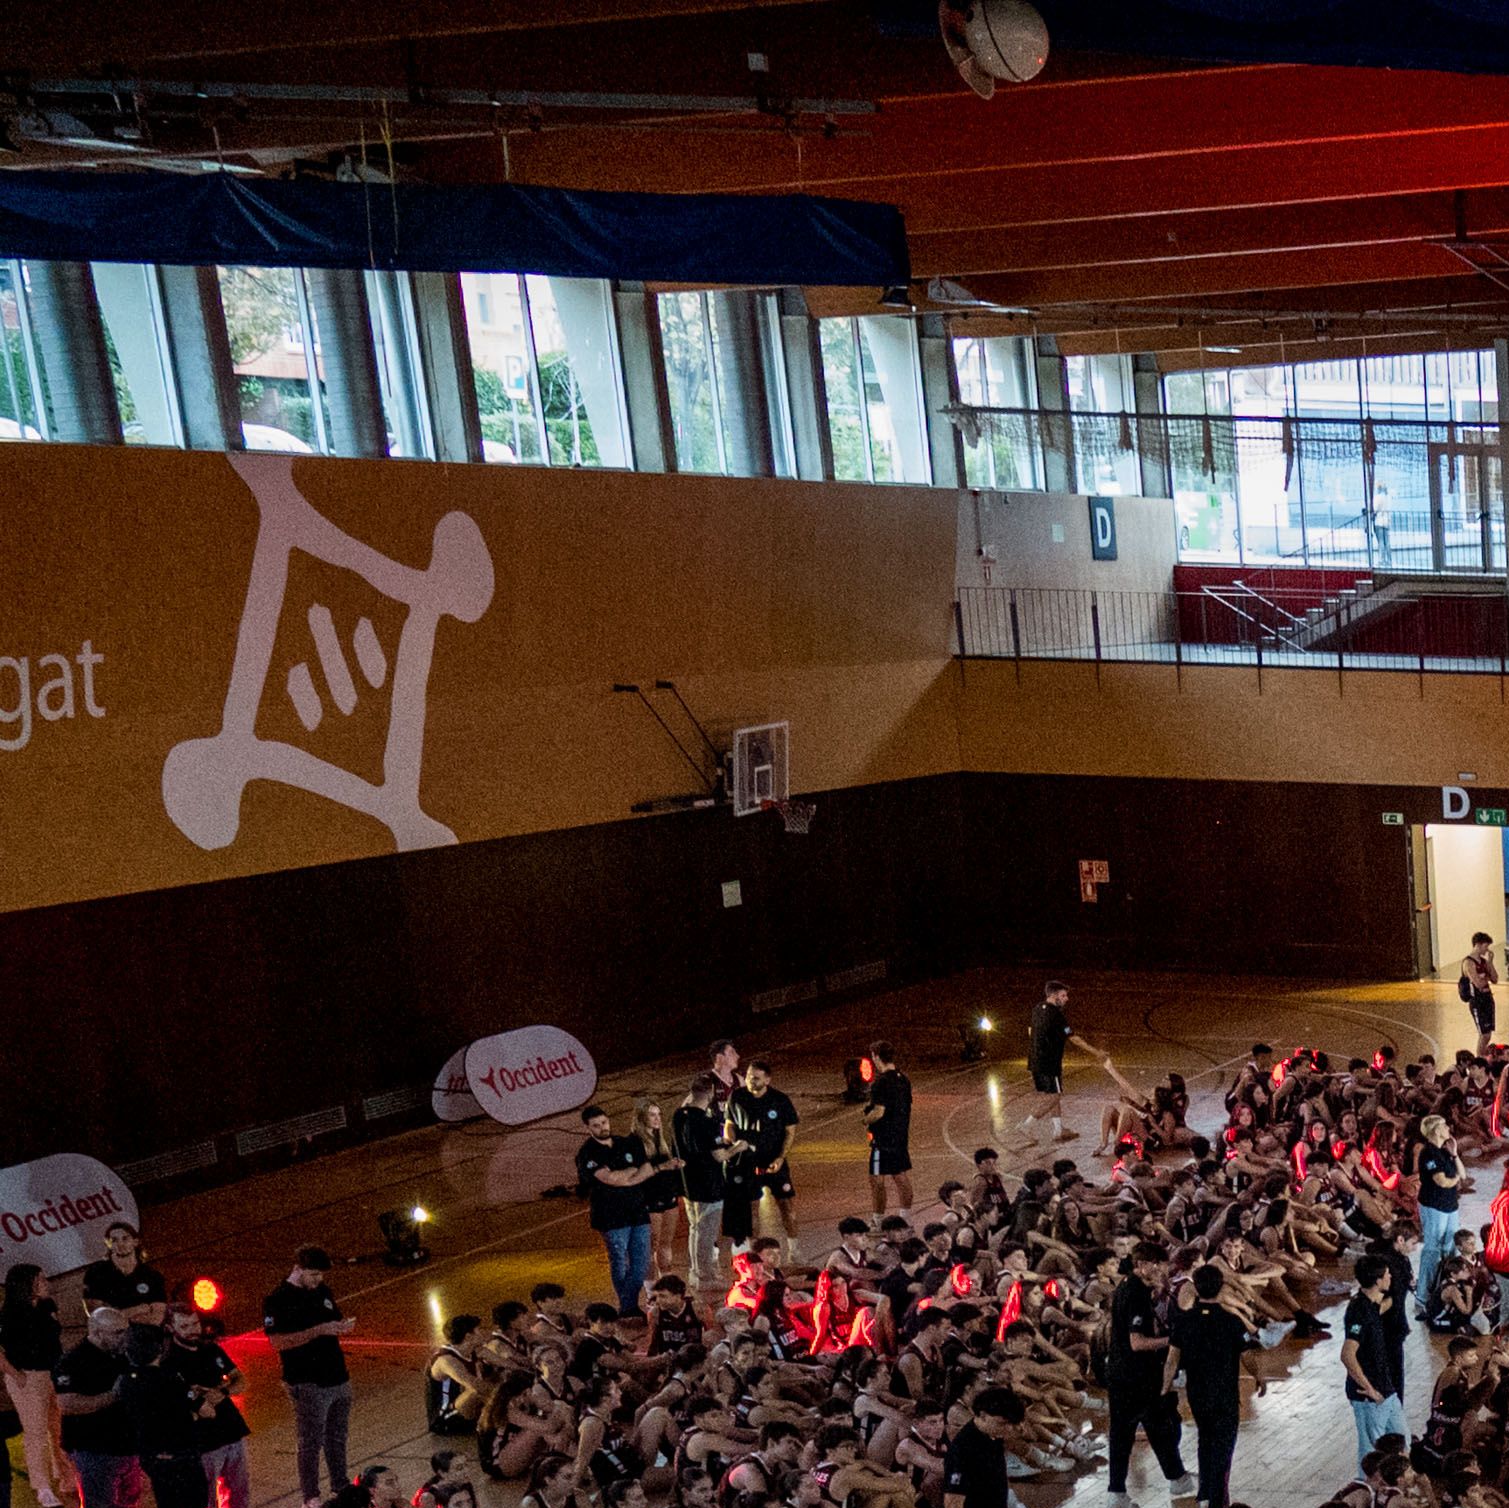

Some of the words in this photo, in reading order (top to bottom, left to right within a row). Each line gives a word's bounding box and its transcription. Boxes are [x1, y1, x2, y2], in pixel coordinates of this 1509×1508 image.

[1095, 506, 1110, 549] D
[1442, 786, 1469, 820] D
[499, 1051, 584, 1092] Occident
[1, 1185, 122, 1242] Occident
